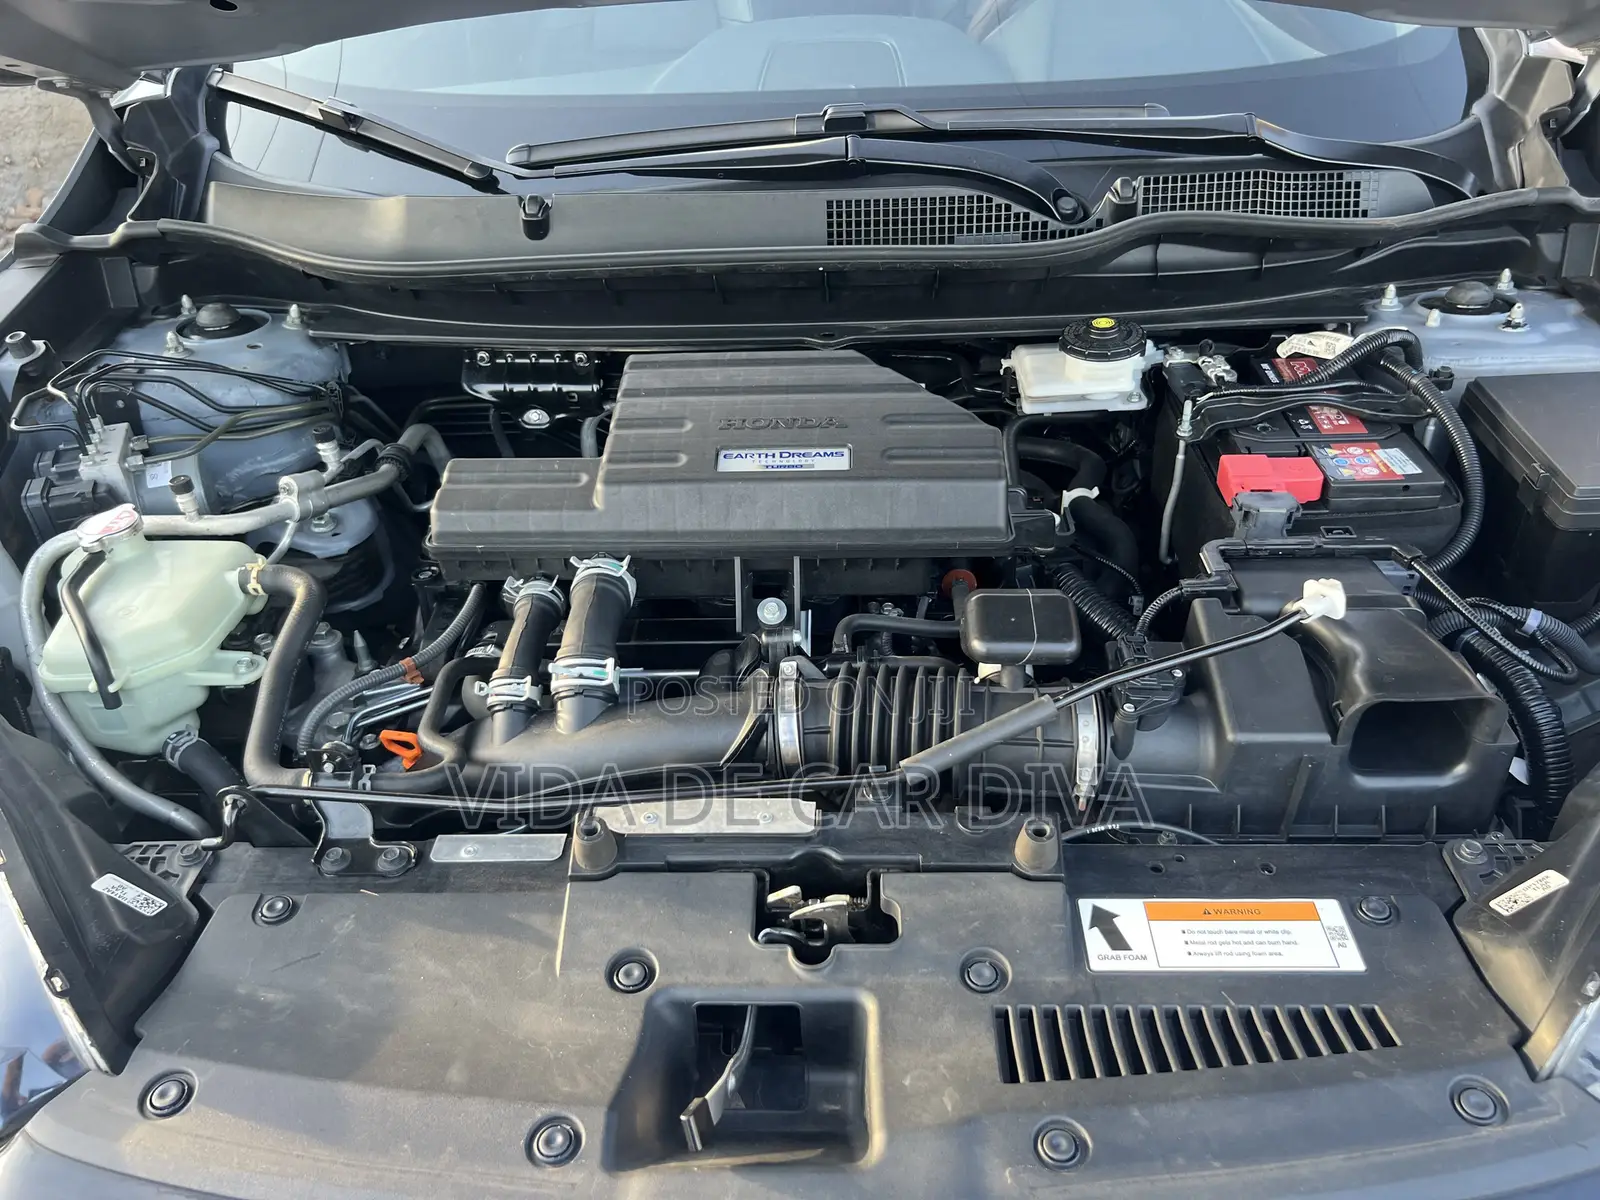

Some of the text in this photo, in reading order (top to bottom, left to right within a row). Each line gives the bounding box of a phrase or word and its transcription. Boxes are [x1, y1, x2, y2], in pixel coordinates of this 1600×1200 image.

[718, 417, 848, 430] HONDA
[723, 451, 845, 460] EARTH DREAMS
[1213, 908, 1262, 916] WARNING
